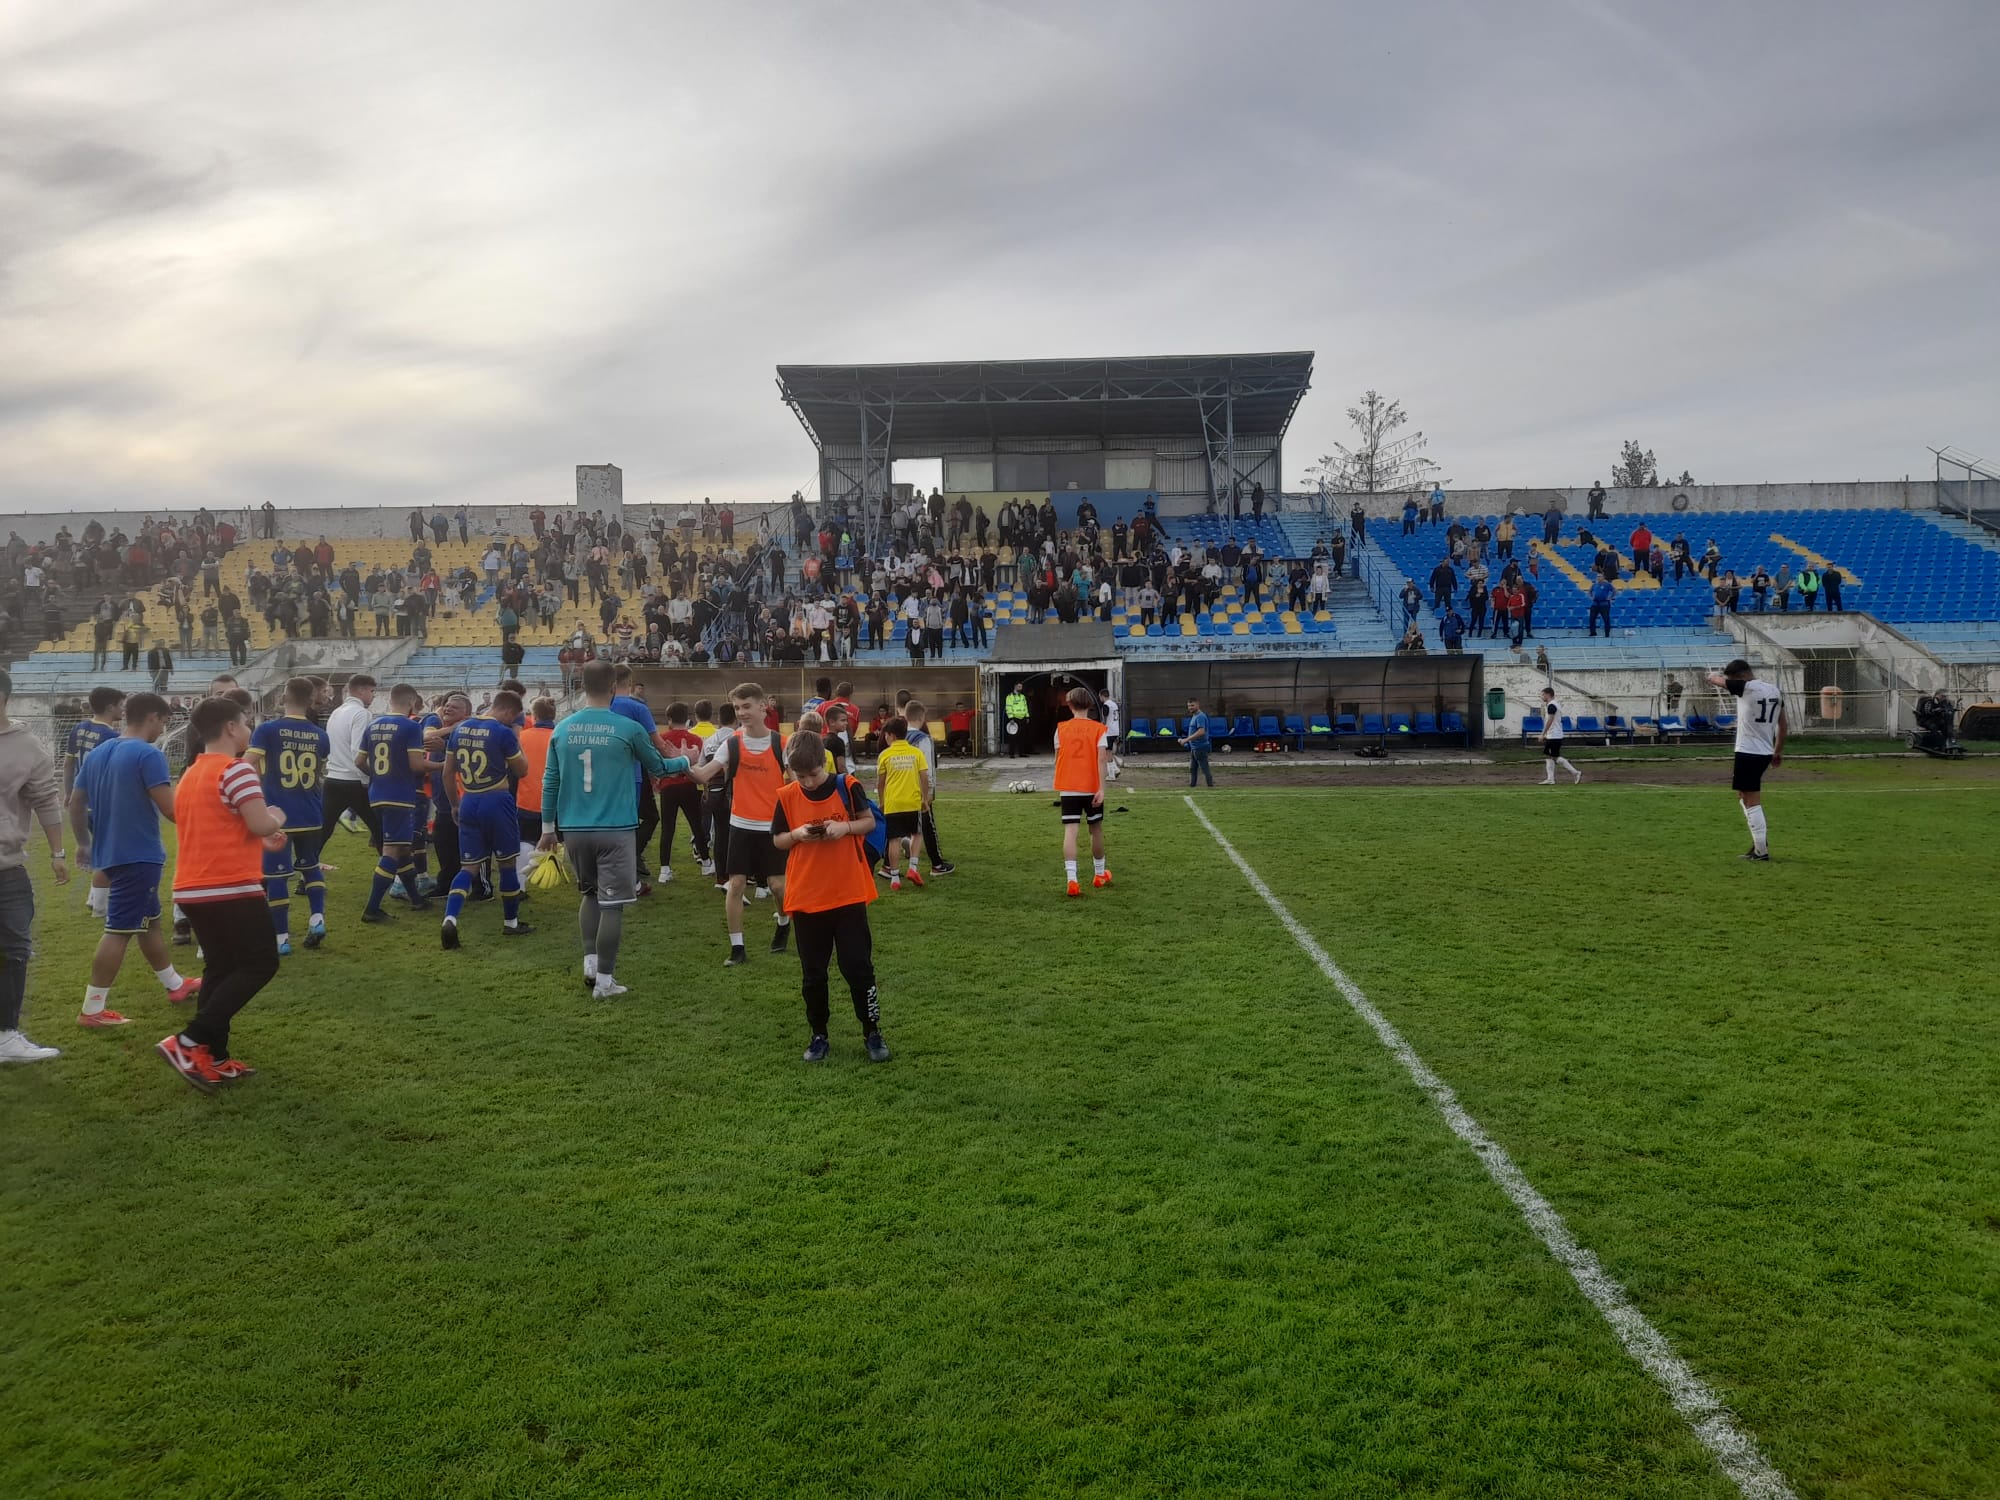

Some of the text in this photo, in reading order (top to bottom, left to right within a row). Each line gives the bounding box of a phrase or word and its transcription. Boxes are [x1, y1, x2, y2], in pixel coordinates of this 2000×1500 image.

[1755, 698, 1778, 723] 17
[279, 728, 320, 741] CSM OLIMPIA
[567, 722, 615, 734] CSM OLIMPIA
[282, 741, 317, 753] SATU MARE
[567, 735, 609, 746] SATU MARE
[1071, 738, 1085, 759] 2
[279, 749, 317, 790] 98
[374, 742, 389, 776] 8
[456, 748, 491, 784] 32
[578, 749, 592, 792] 1
